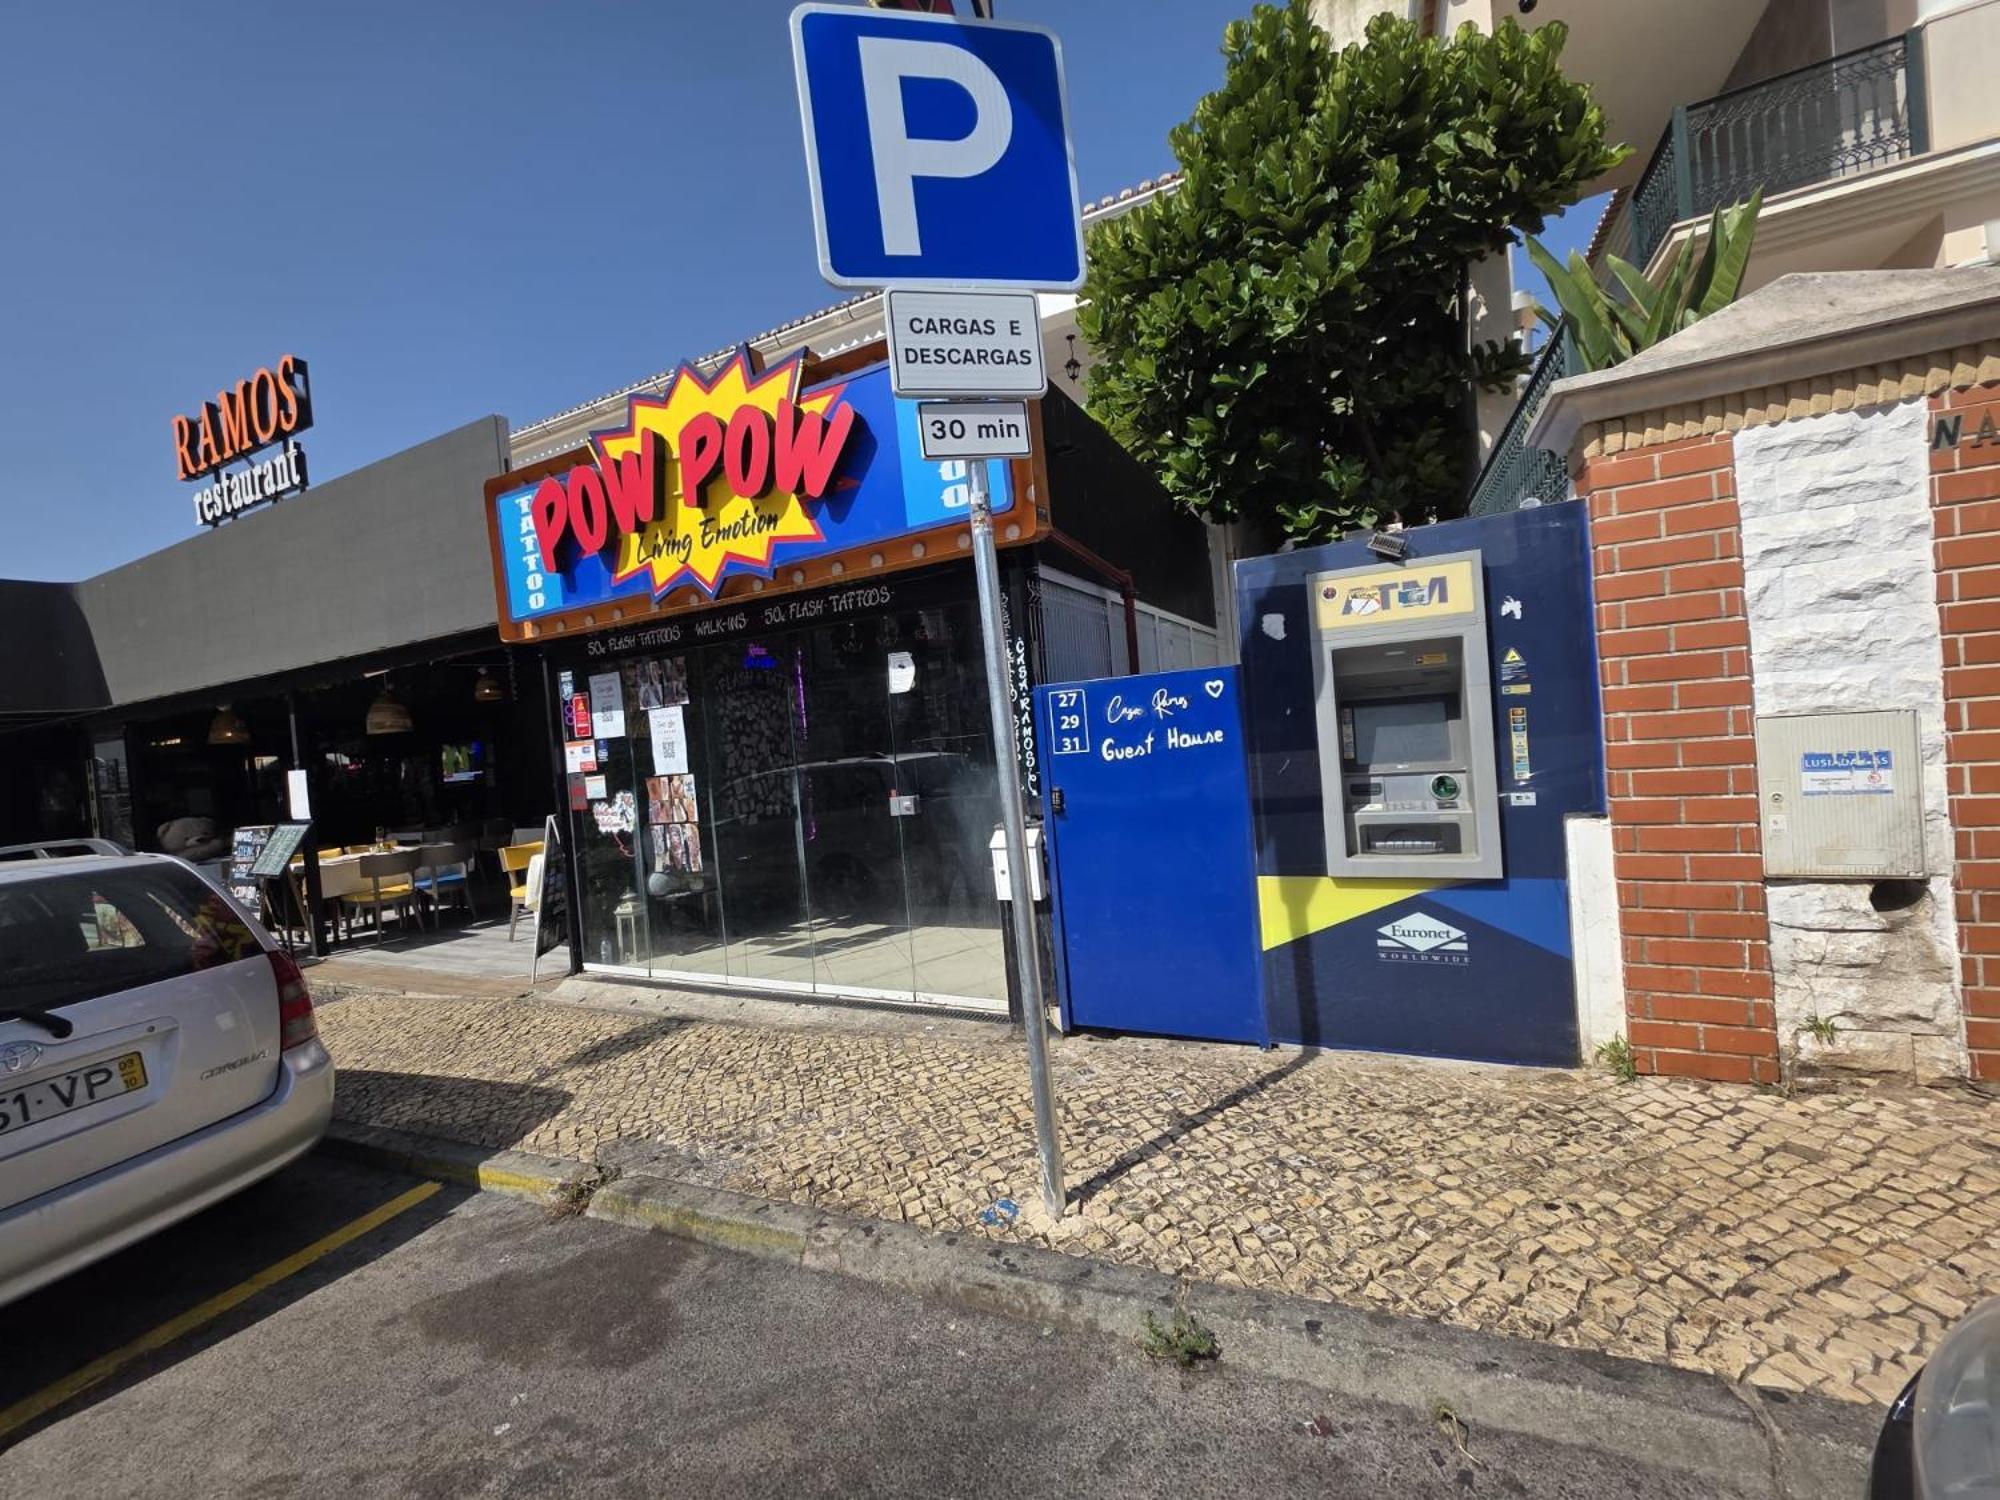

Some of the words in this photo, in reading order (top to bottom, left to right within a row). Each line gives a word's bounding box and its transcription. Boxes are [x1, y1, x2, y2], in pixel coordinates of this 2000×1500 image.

[858, 35, 1013, 256] P
[908, 317, 996, 336] CARGAS
[1010, 319, 1022, 336] E
[904, 347, 1033, 367] DESCARGAS
[171, 354, 300, 481] RAMOS
[930, 418, 966, 441] 30
[977, 416, 1021, 440] min
[193, 439, 301, 526] restaurant
[531, 427, 655, 574] POW
[678, 397, 855, 509] POW
[636, 531, 693, 565] Living
[698, 505, 779, 550] Emotion
[515, 494, 546, 610] TATTOO
[1058, 693, 1078, 708] 27
[1060, 715, 1080, 730] 29
[1062, 737, 1080, 752] 31
[1101, 729, 1155, 762] Guest
[1167, 727, 1224, 750] House
[1391, 924, 1452, 939] Euronet
[1378, 952, 1472, 964] WORLDWIDE
